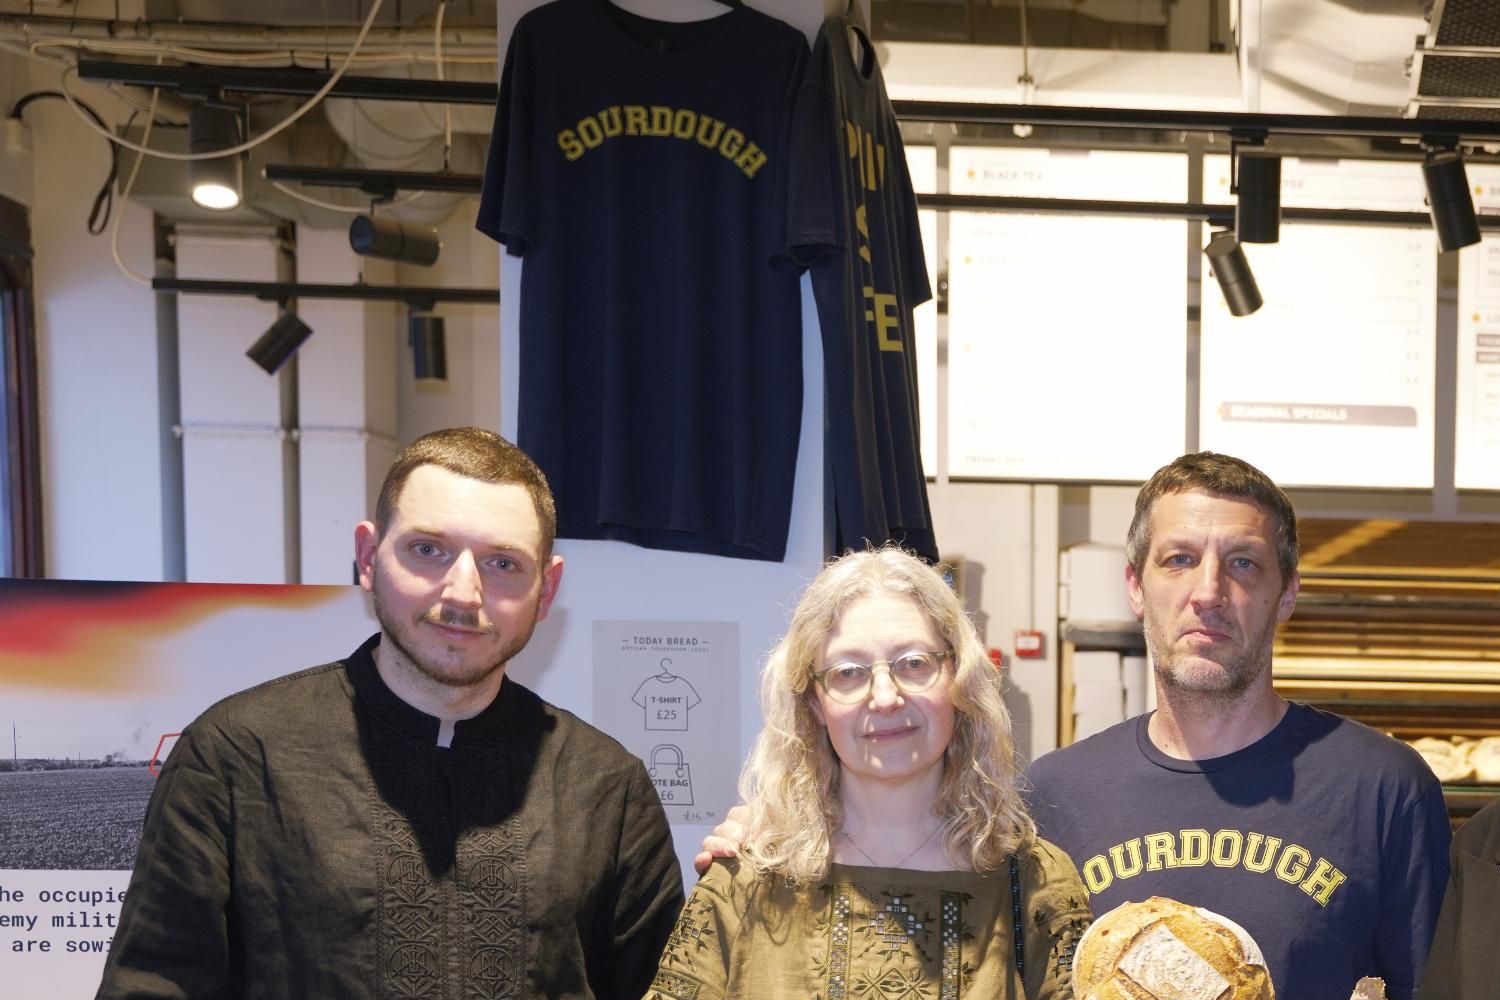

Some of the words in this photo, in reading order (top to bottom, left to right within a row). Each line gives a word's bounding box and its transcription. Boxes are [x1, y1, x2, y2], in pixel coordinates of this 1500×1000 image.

[556, 105, 768, 179] SOURDOUGH
[633, 636, 663, 645] TODAY
[667, 637, 698, 646] BREAD
[651, 696, 682, 704] T-SHIRT
[656, 709, 677, 720] £25
[661, 790, 674, 801] £6
[1083, 829, 1347, 907] OURDOUGH
[39, 887, 127, 907] occupie
[52, 912, 117, 928] milit
[12, 940, 51, 953] are
